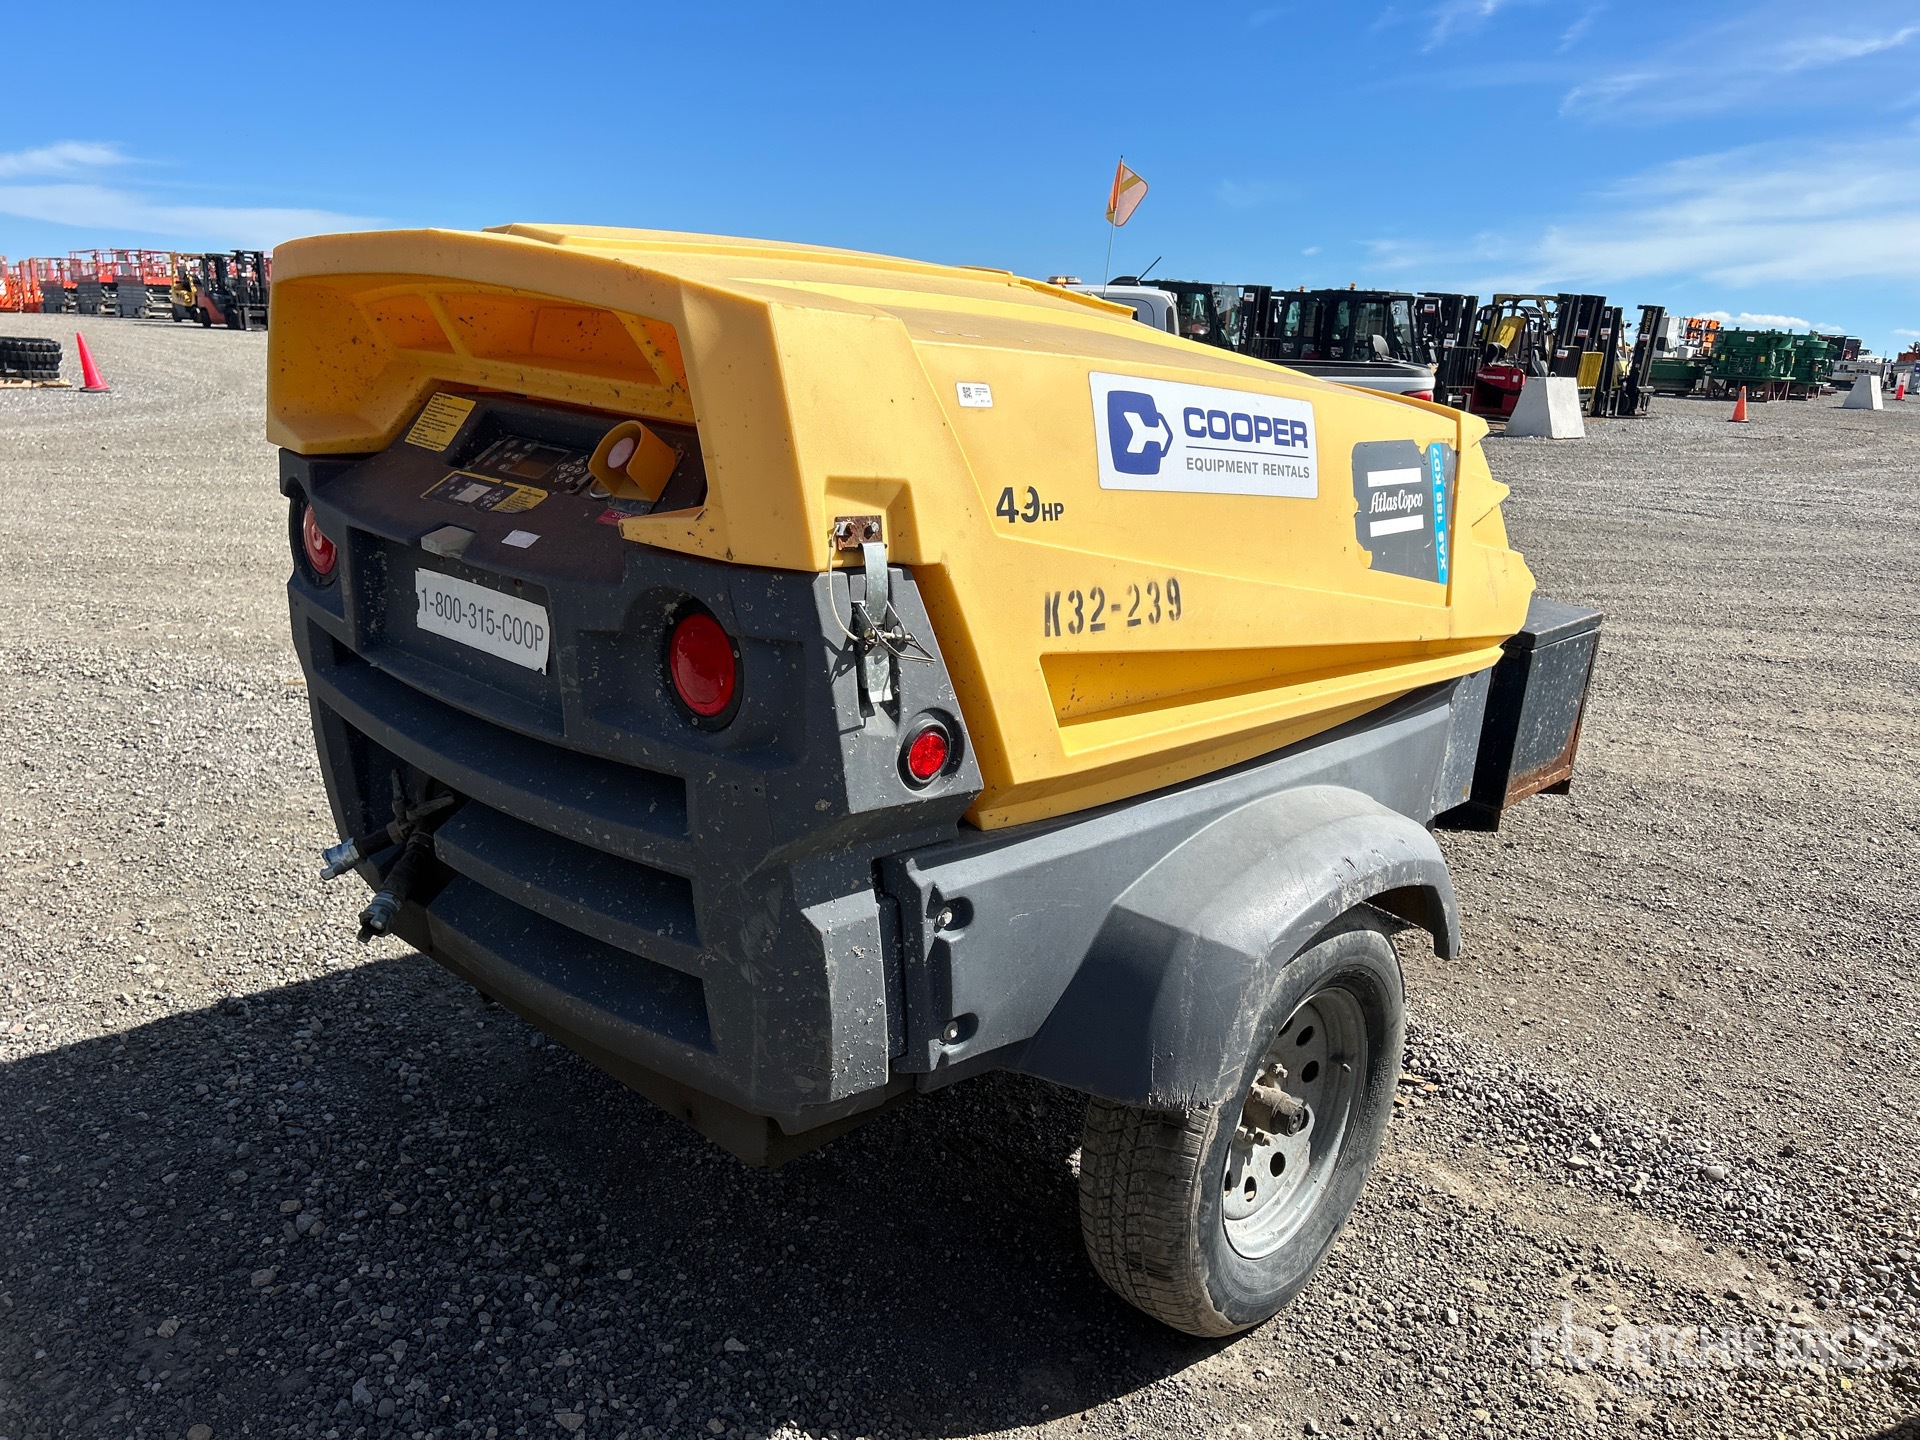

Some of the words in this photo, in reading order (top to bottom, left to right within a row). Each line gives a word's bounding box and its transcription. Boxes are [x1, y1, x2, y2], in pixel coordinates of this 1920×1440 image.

[1183, 406, 1309, 449] COOPER
[1186, 457, 1259, 475] EQUIPMENT
[1262, 463, 1310, 479] RENTALS
[1432, 448, 1442, 485] KD7
[1437, 530, 1447, 570] XAS
[421, 587, 544, 651] 1-800-315-COOP
[1044, 577, 1182, 637] K32-239
